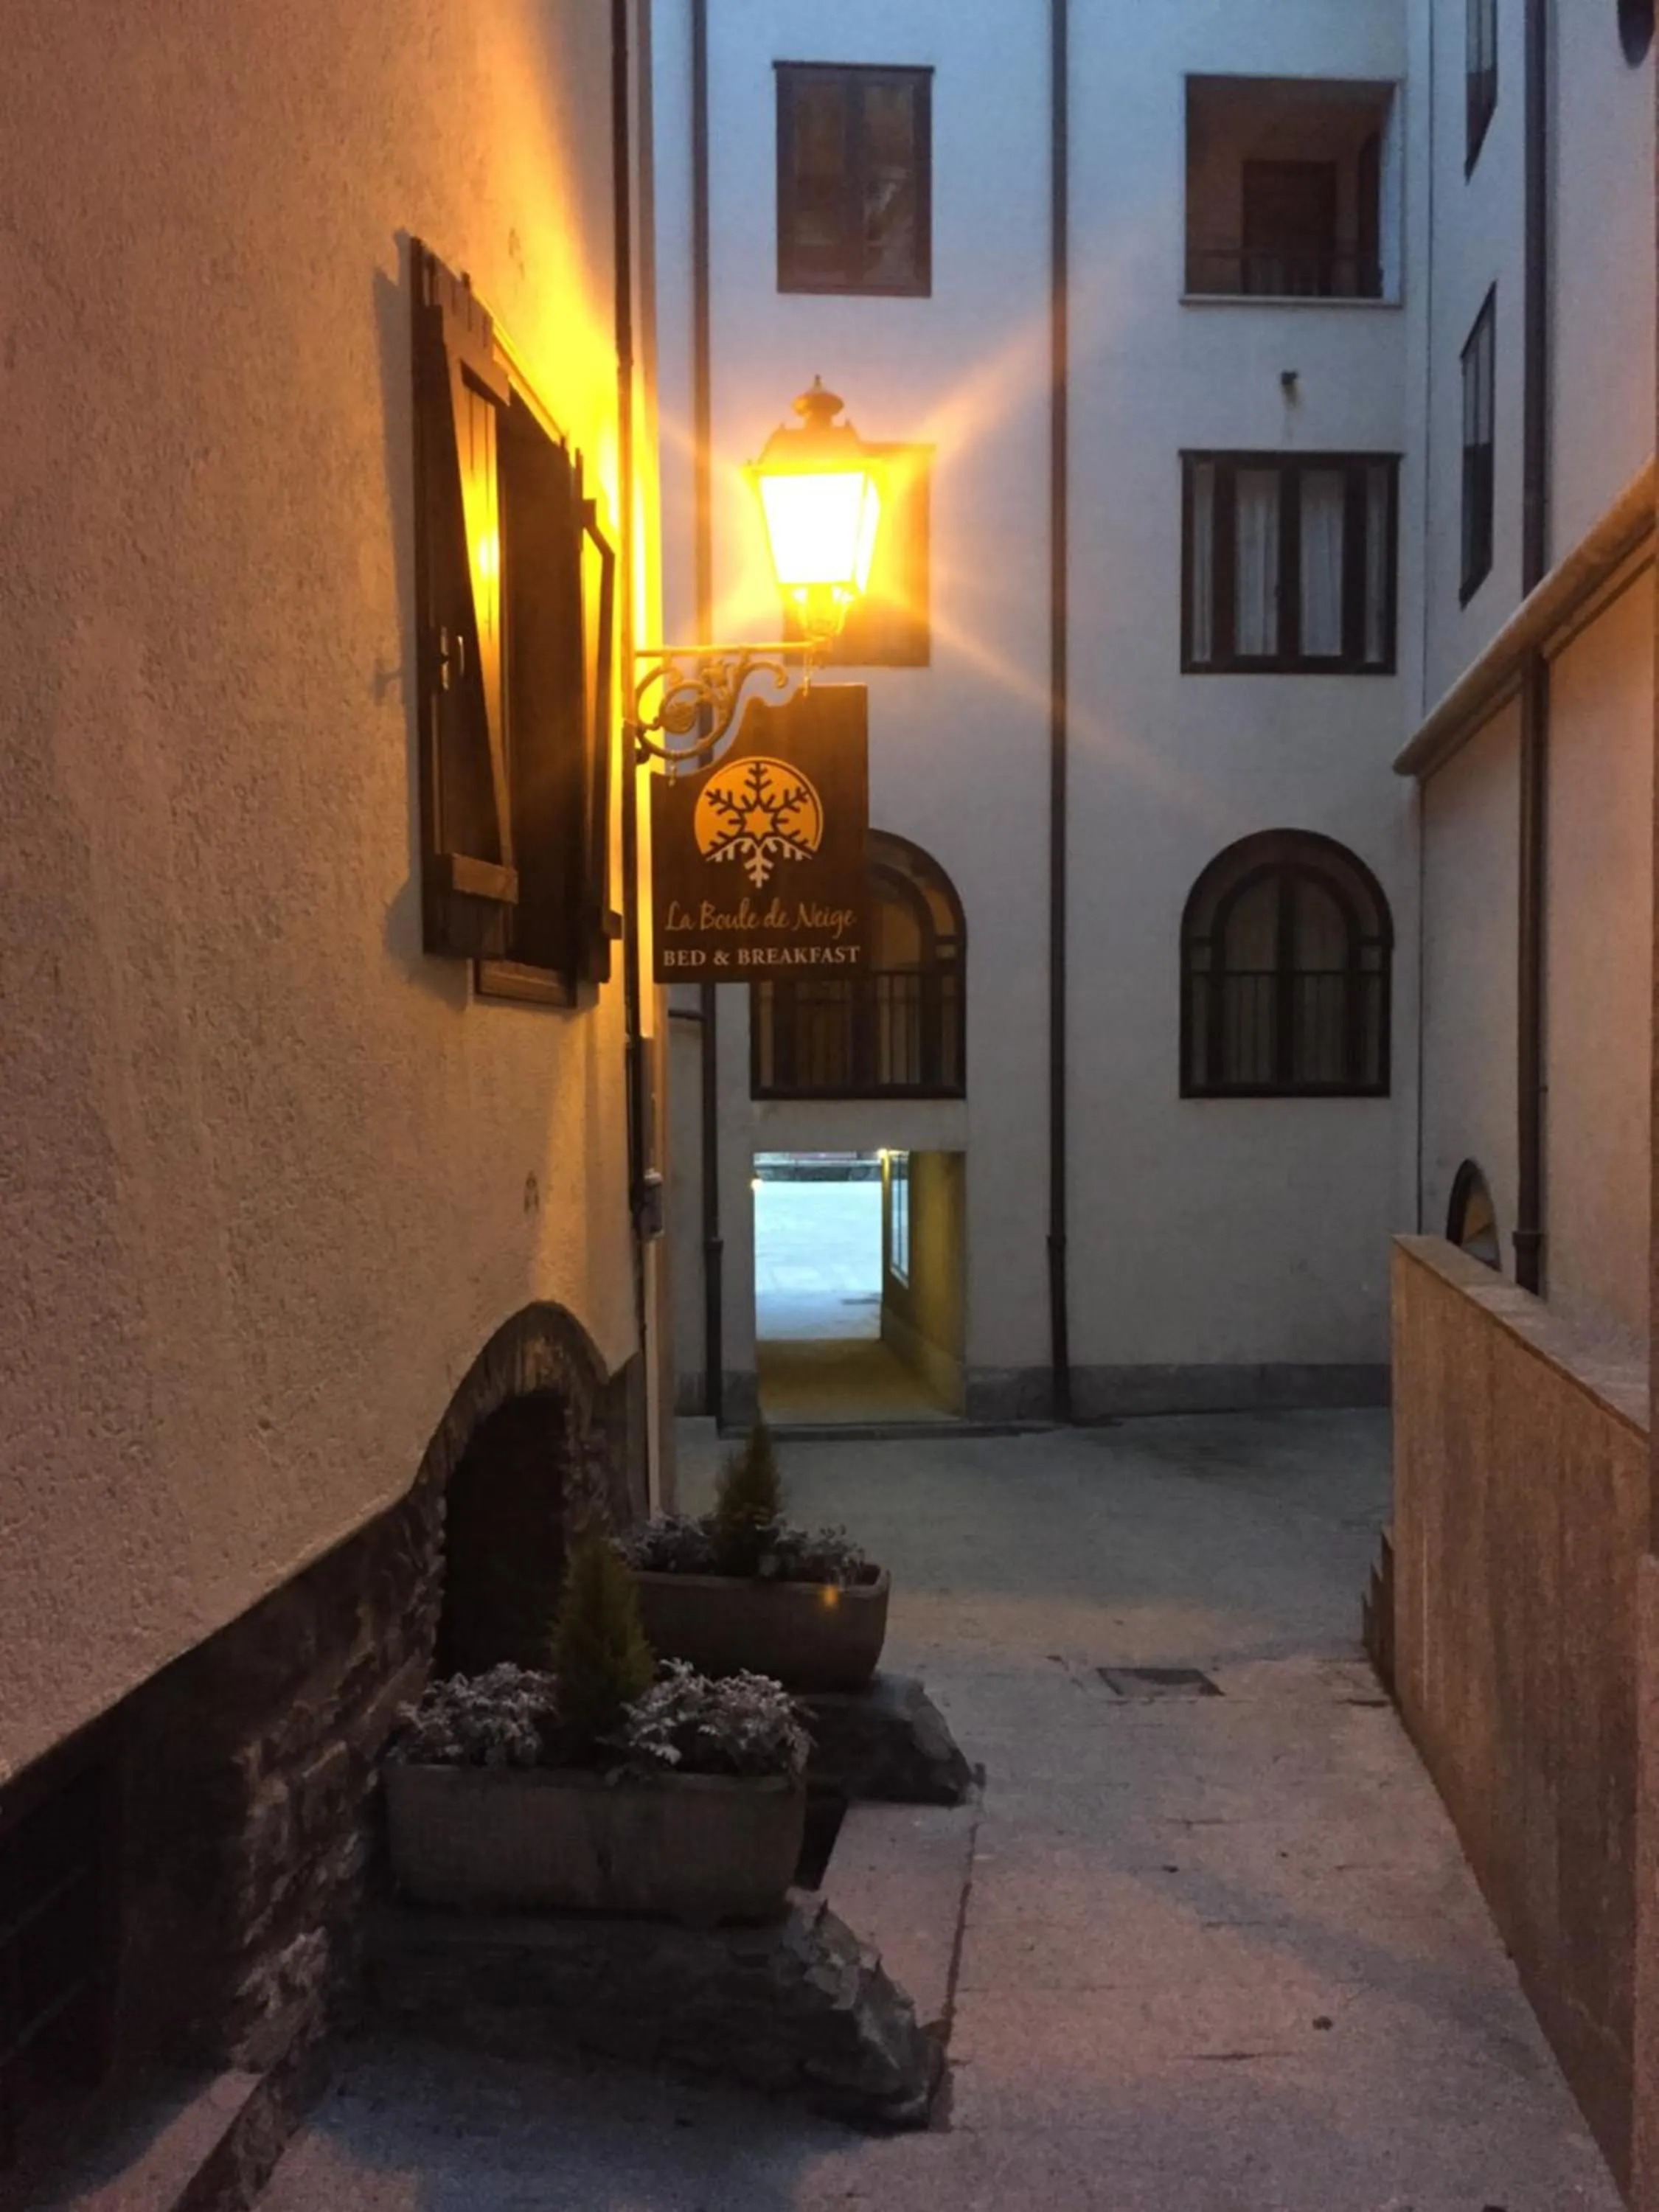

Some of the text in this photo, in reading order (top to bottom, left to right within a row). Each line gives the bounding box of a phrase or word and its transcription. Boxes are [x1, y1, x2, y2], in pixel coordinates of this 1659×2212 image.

[664, 897, 856, 940] La Boule de Neige
[663, 946, 860, 967] BED & BREAKFAST
